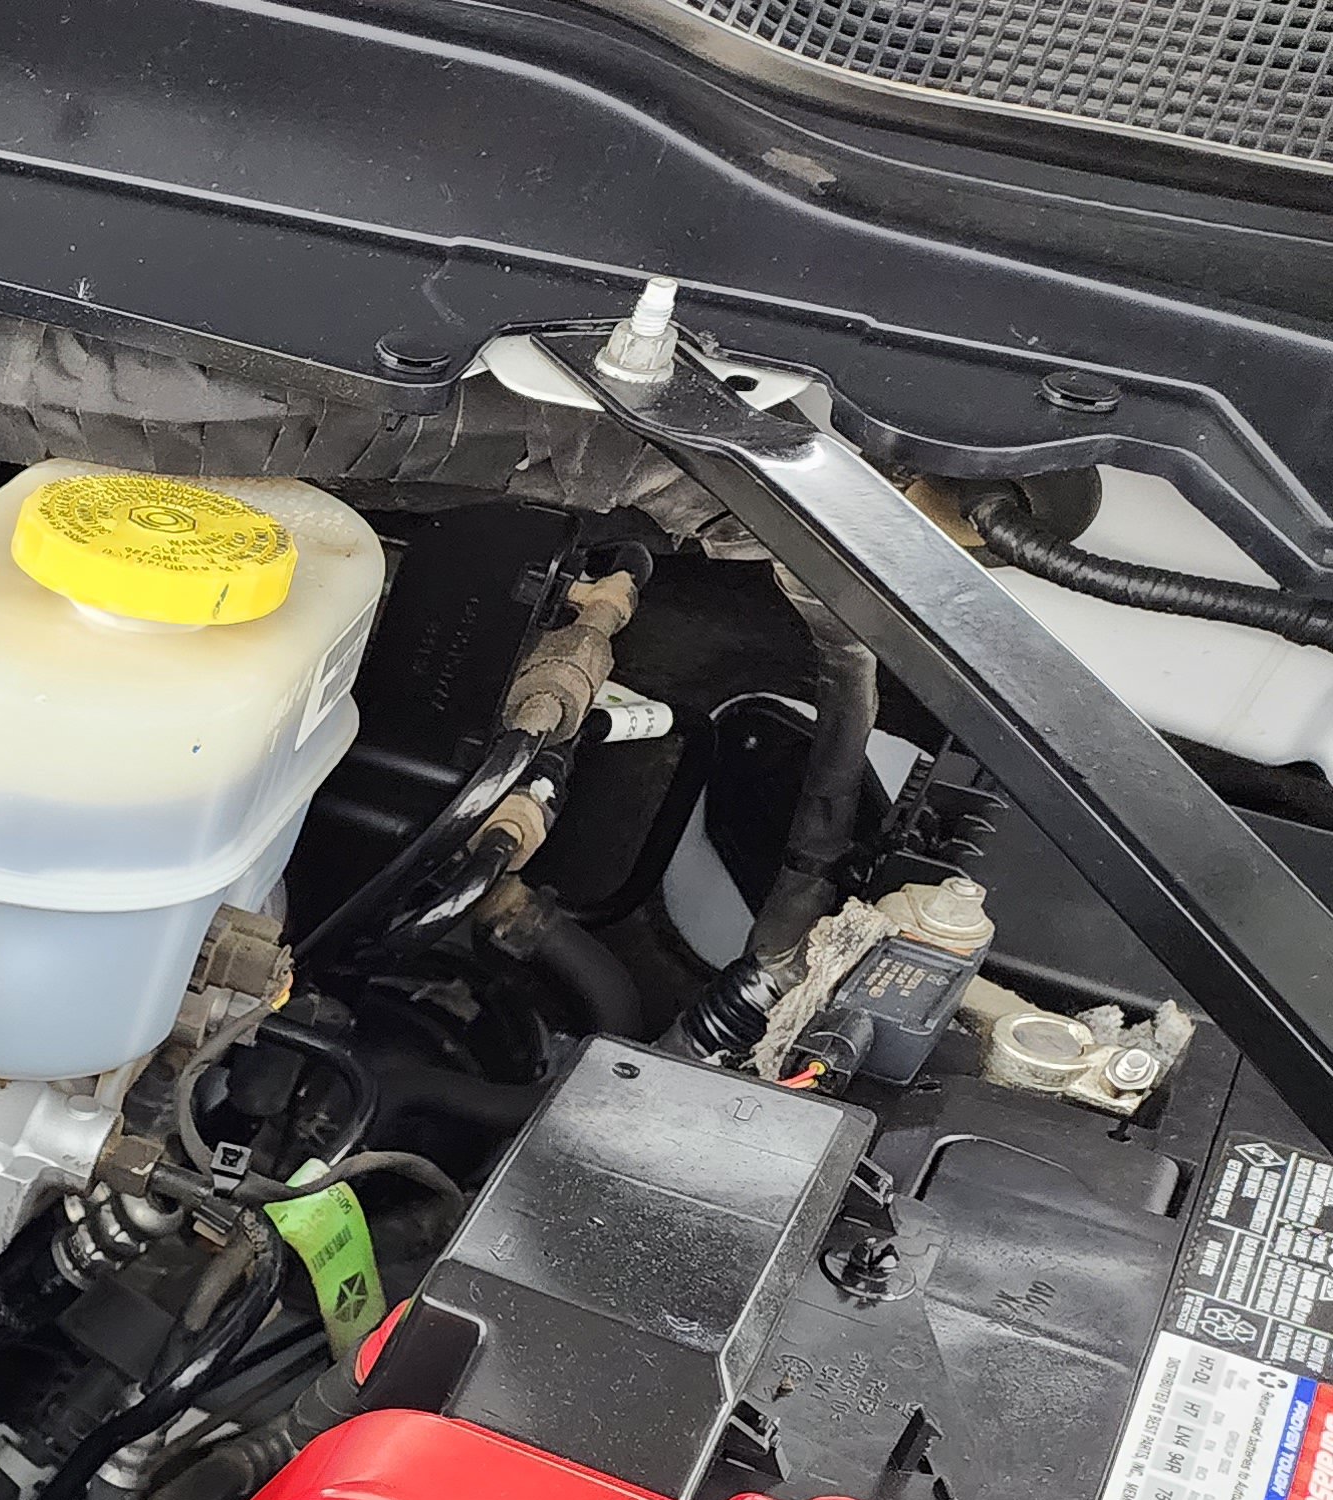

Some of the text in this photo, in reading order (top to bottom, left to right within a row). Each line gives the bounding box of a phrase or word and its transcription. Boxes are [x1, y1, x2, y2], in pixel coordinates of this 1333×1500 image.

[1159, 1355, 1181, 1405] DISTRIBUTED
[1191, 1353, 1215, 1387] H7-DL
[1149, 1402, 1165, 1415] BY
[1181, 1400, 1201, 1419] H7
[1255, 1390, 1273, 1417] Return
[1144, 1413, 1162, 1436] BEST
[1172, 1424, 1194, 1448] LN4
[1250, 1416, 1265, 1435] used
[1239, 1435, 1259, 1470] batteries
[1269, 1399, 1308, 1496] PROVEN TOUGH
[1163, 1450, 1186, 1475] 94R
